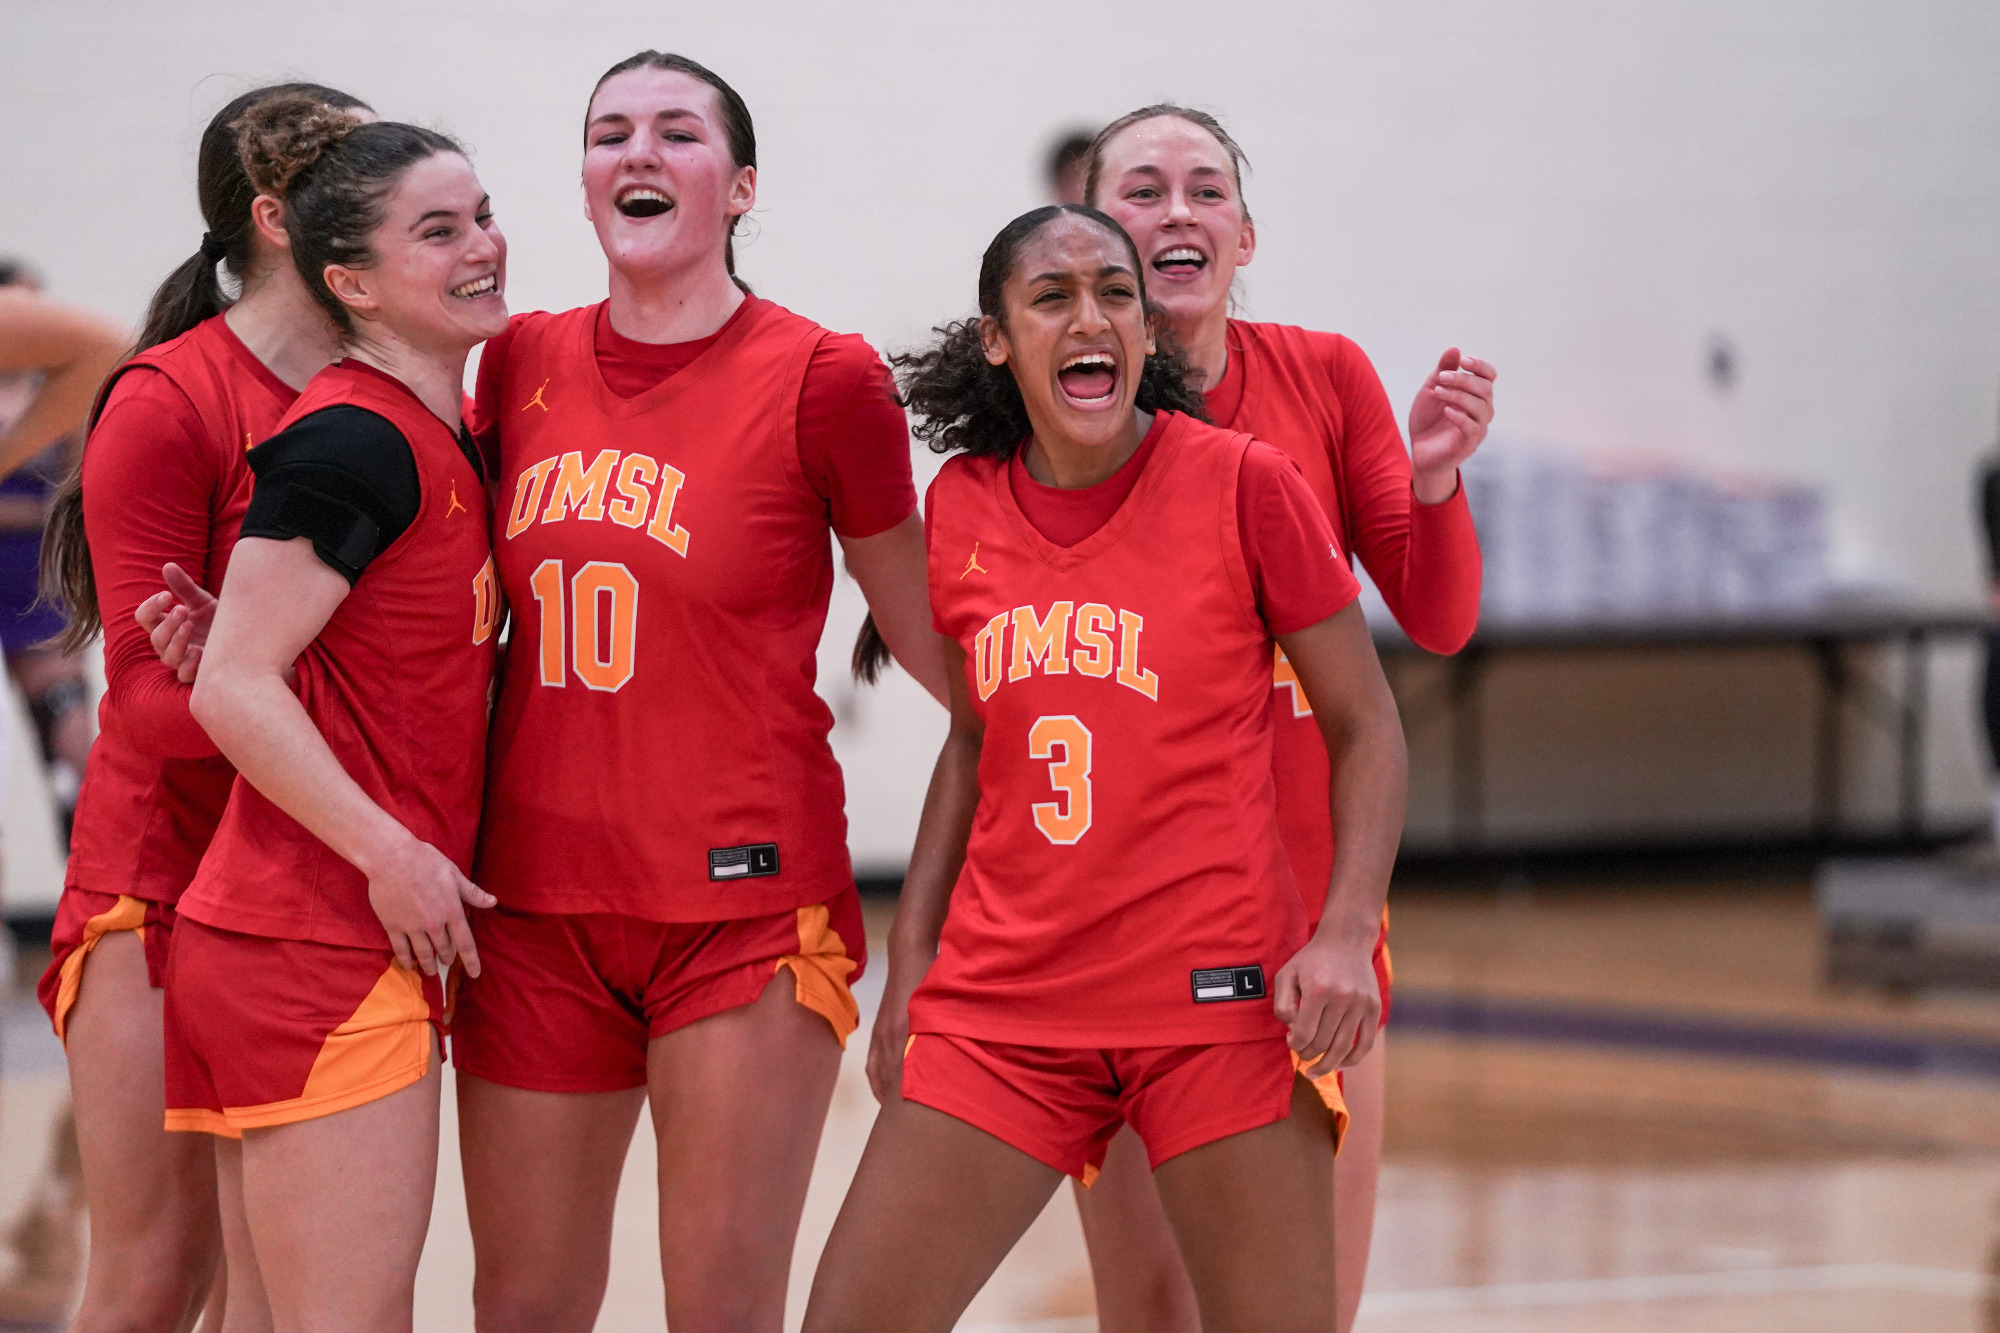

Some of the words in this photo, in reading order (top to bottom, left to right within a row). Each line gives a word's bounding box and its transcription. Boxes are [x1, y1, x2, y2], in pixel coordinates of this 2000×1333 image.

[505, 449, 691, 559] UMSL
[472, 556, 498, 648] U
[529, 558, 640, 694] 10
[974, 600, 1159, 703] UMSL
[1028, 714, 1093, 846] 3
[759, 853, 767, 867] L
[1244, 975, 1253, 990] L
